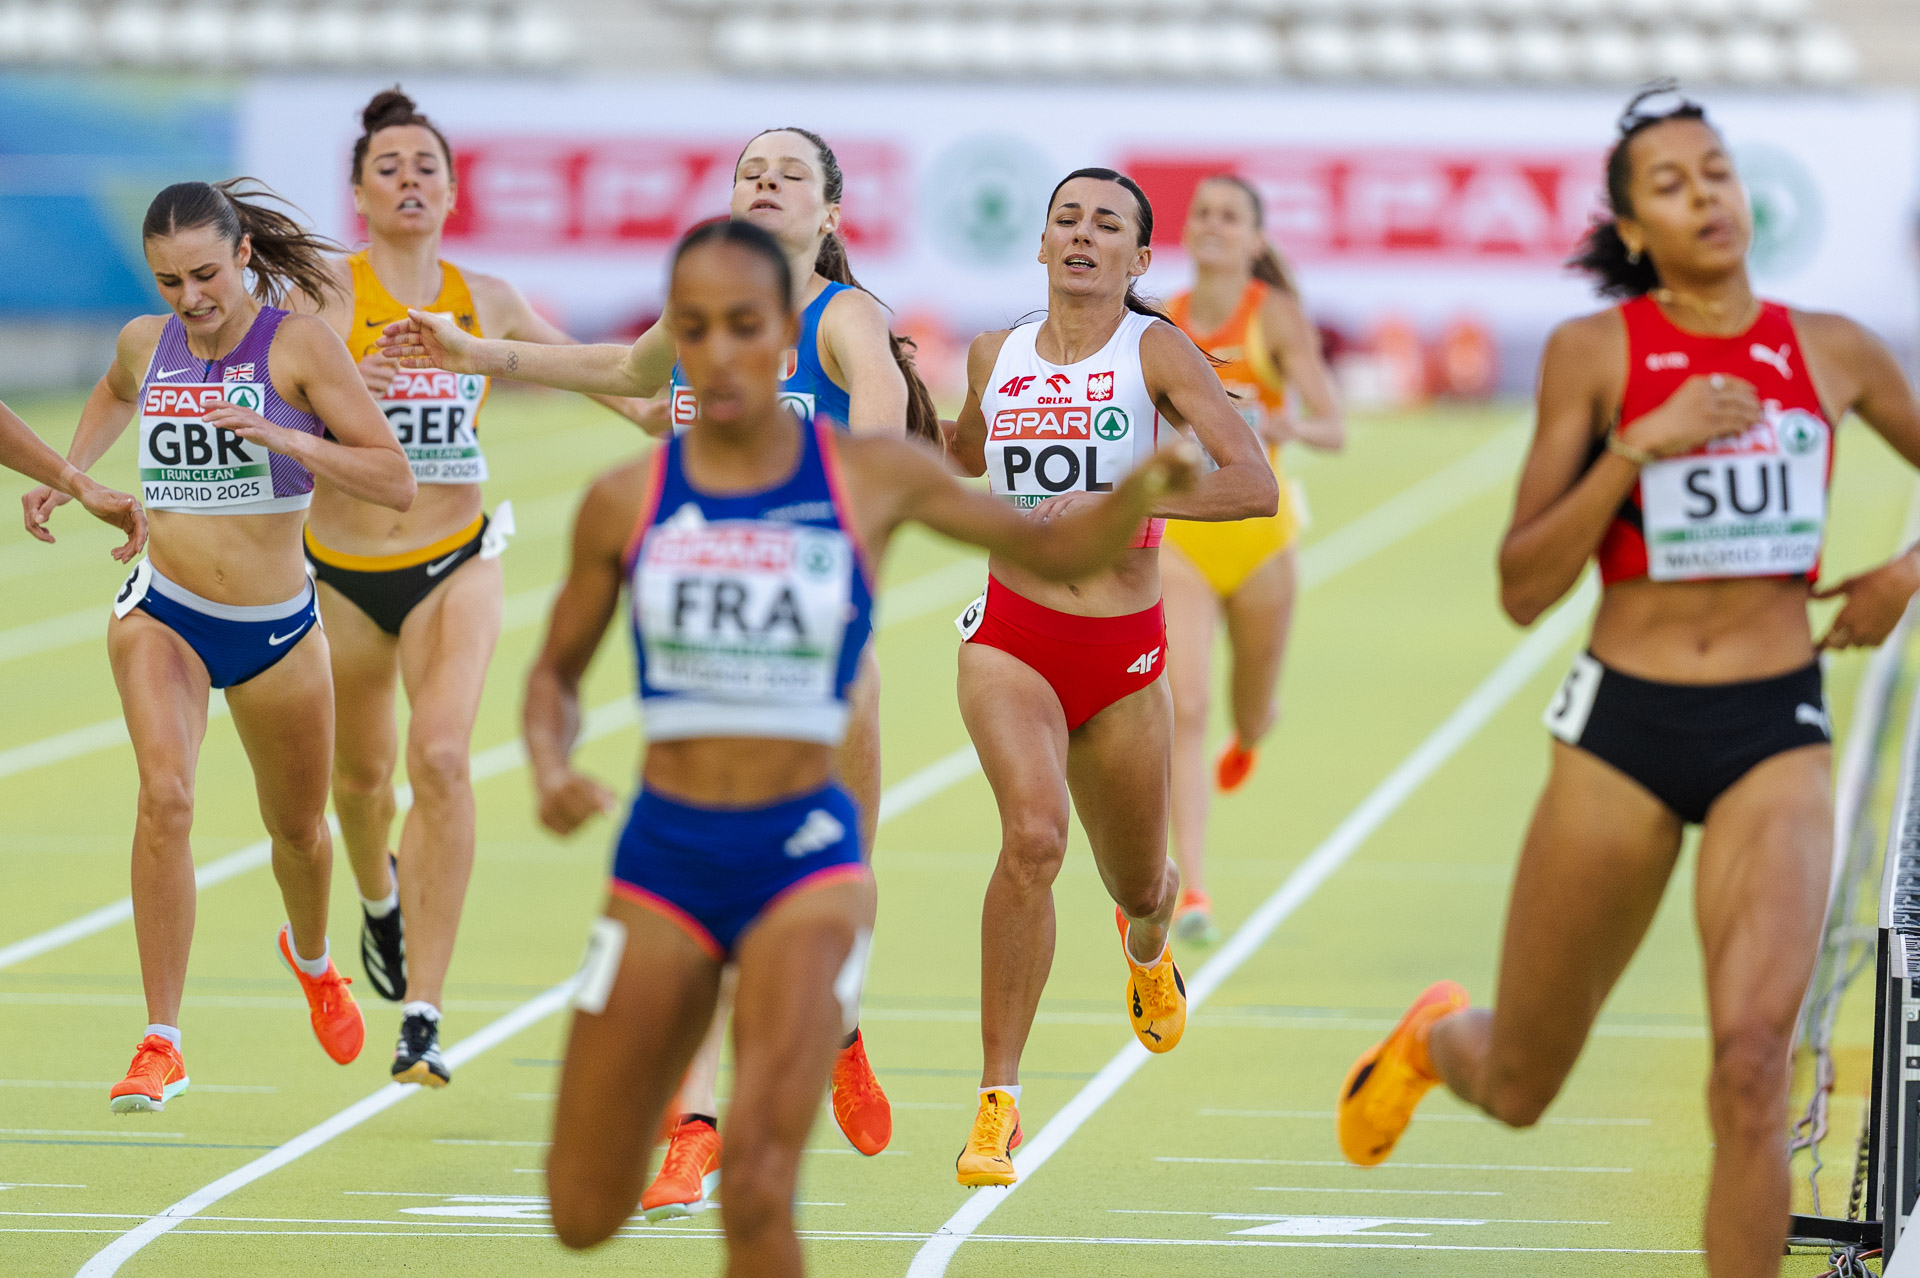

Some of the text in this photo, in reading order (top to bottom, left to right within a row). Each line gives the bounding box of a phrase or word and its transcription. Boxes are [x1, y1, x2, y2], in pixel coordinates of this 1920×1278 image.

[387, 374, 456, 397] PAR
[998, 375, 1037, 397] 4F
[1037, 396, 1073, 405] ORLEN
[384, 406, 470, 444] GER
[994, 411, 1088, 437] SPAR
[148, 422, 254, 466] GBR
[161, 469, 165, 480] I
[167, 469, 192, 481] RUN
[1003, 445, 1113, 493] POL
[145, 482, 260, 501] MADRID 2025
[1014, 496, 1018, 507] I
[1684, 462, 1789, 520] SUI
[672, 577, 808, 637] FRA
[1126, 646, 1160, 675] 4F
